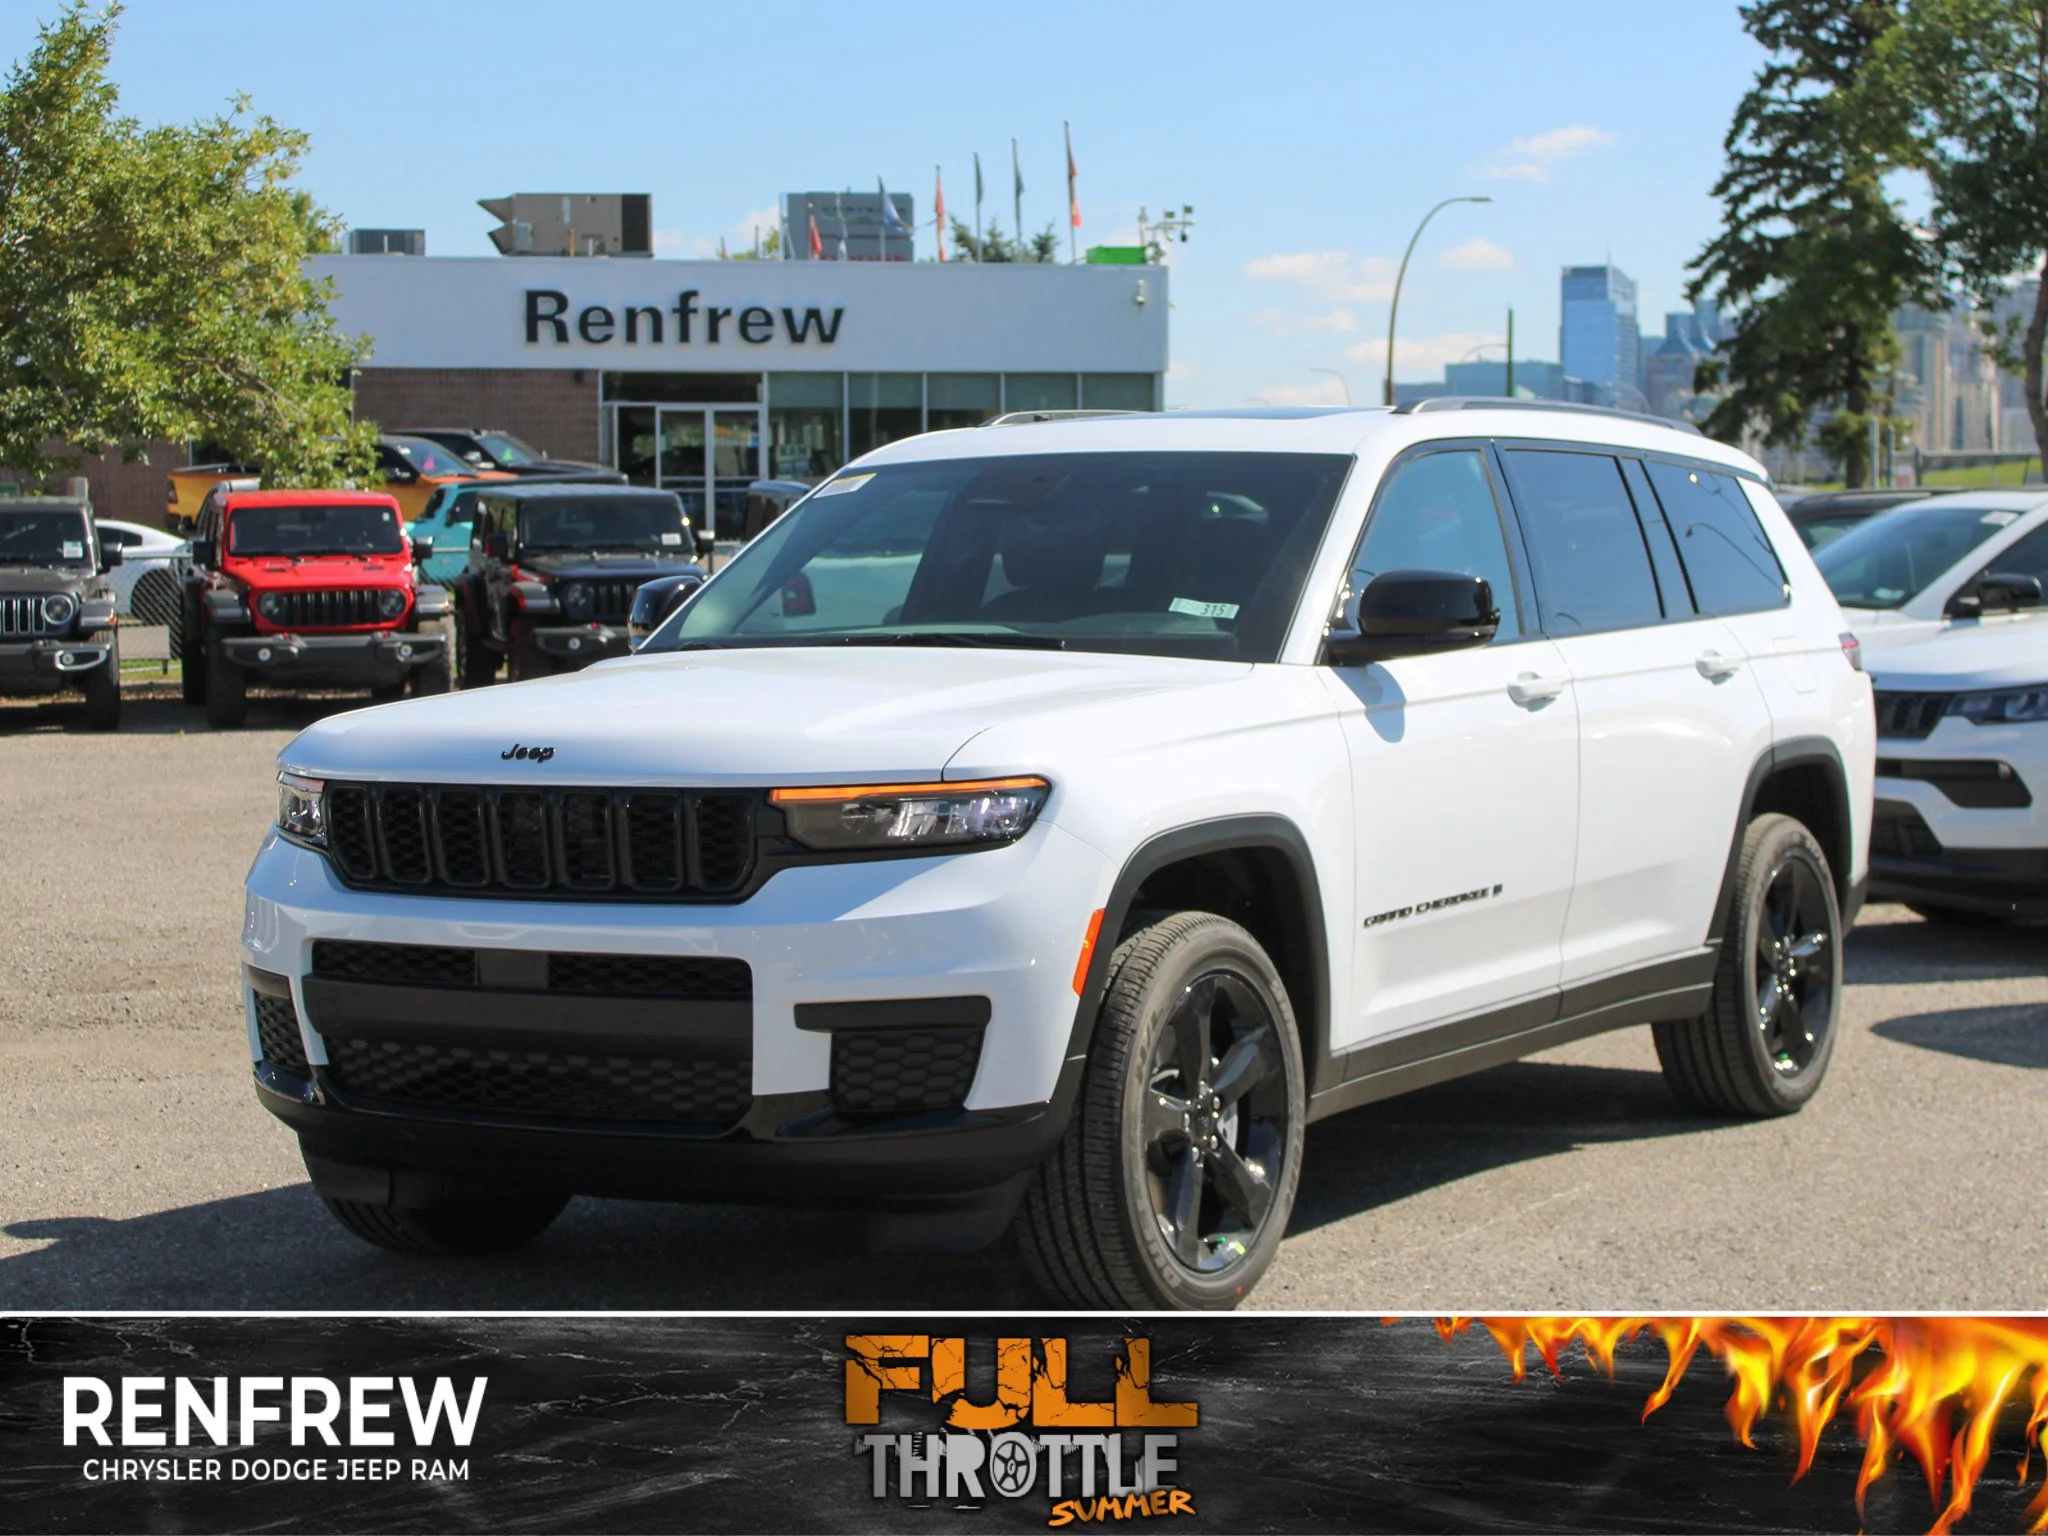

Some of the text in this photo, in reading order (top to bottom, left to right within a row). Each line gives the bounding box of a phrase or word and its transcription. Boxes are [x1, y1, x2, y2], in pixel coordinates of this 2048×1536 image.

[524, 289, 845, 344] Renfrew
[501, 743, 557, 764] Jeep
[1363, 906, 1413, 928] GRAND
[1415, 887, 1489, 914] CHEROKEE
